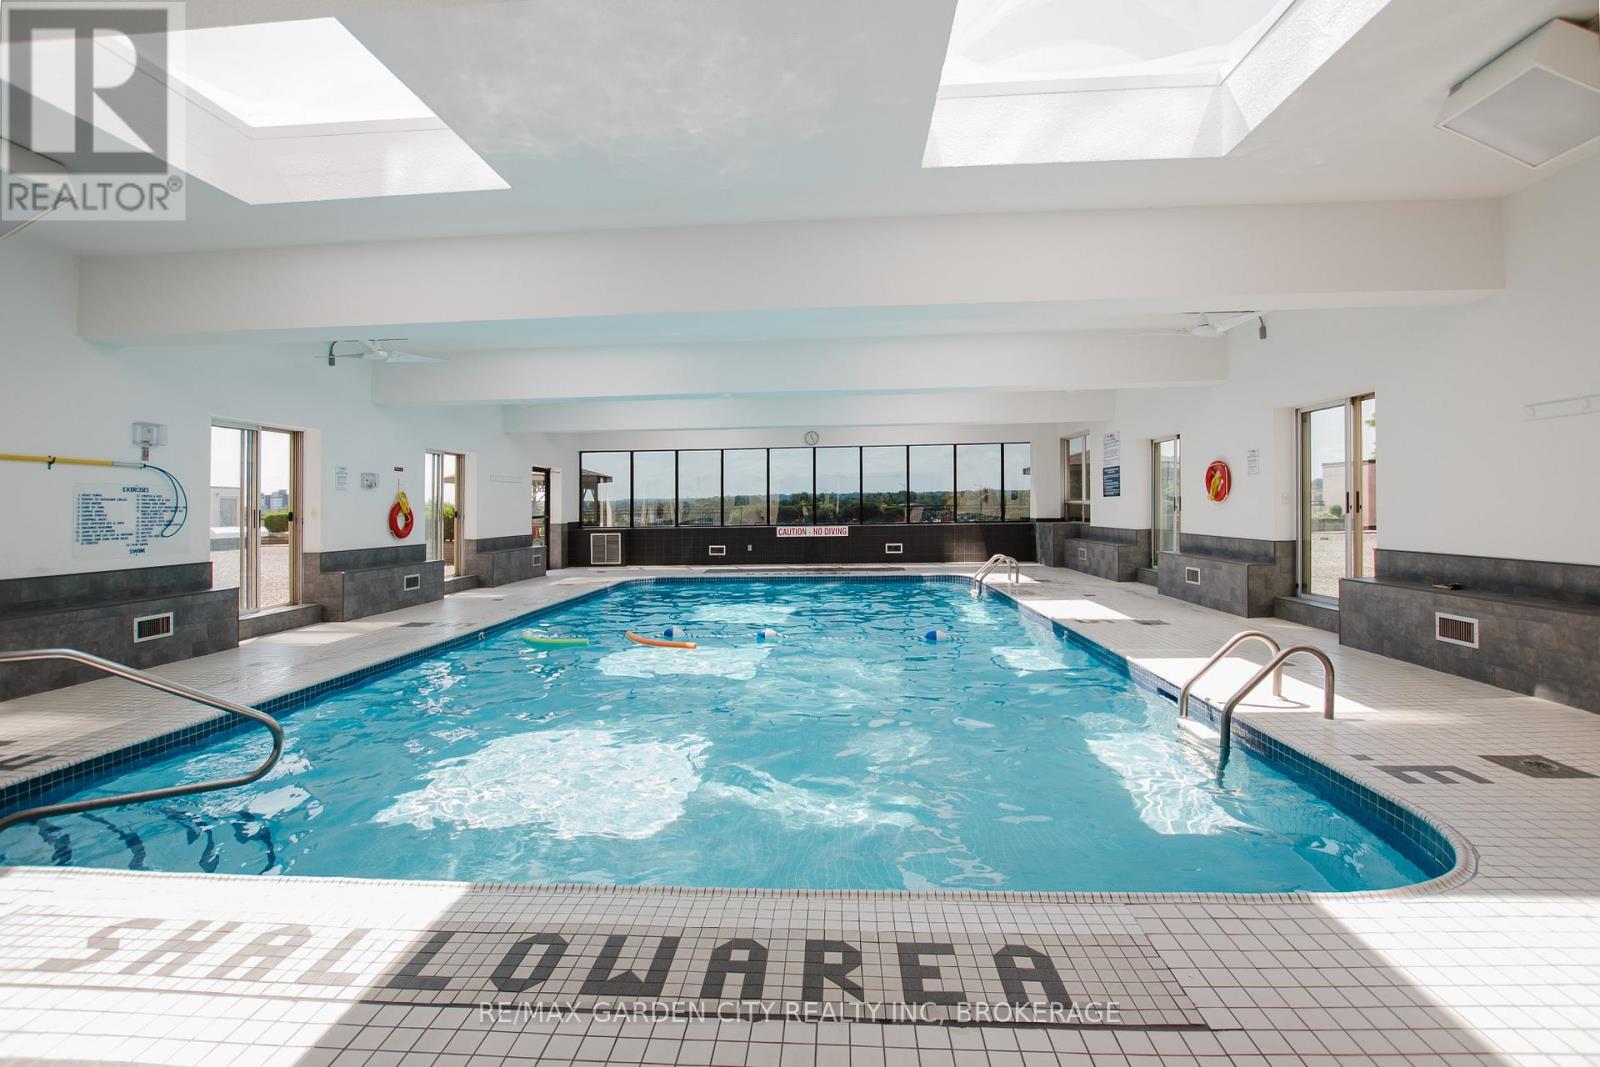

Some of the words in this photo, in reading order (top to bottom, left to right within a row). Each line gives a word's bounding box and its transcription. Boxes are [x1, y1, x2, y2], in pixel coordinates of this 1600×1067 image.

[778, 527, 806, 536] CAUTION
[813, 527, 822, 535] NO
[824, 527, 847, 535] DIVING
